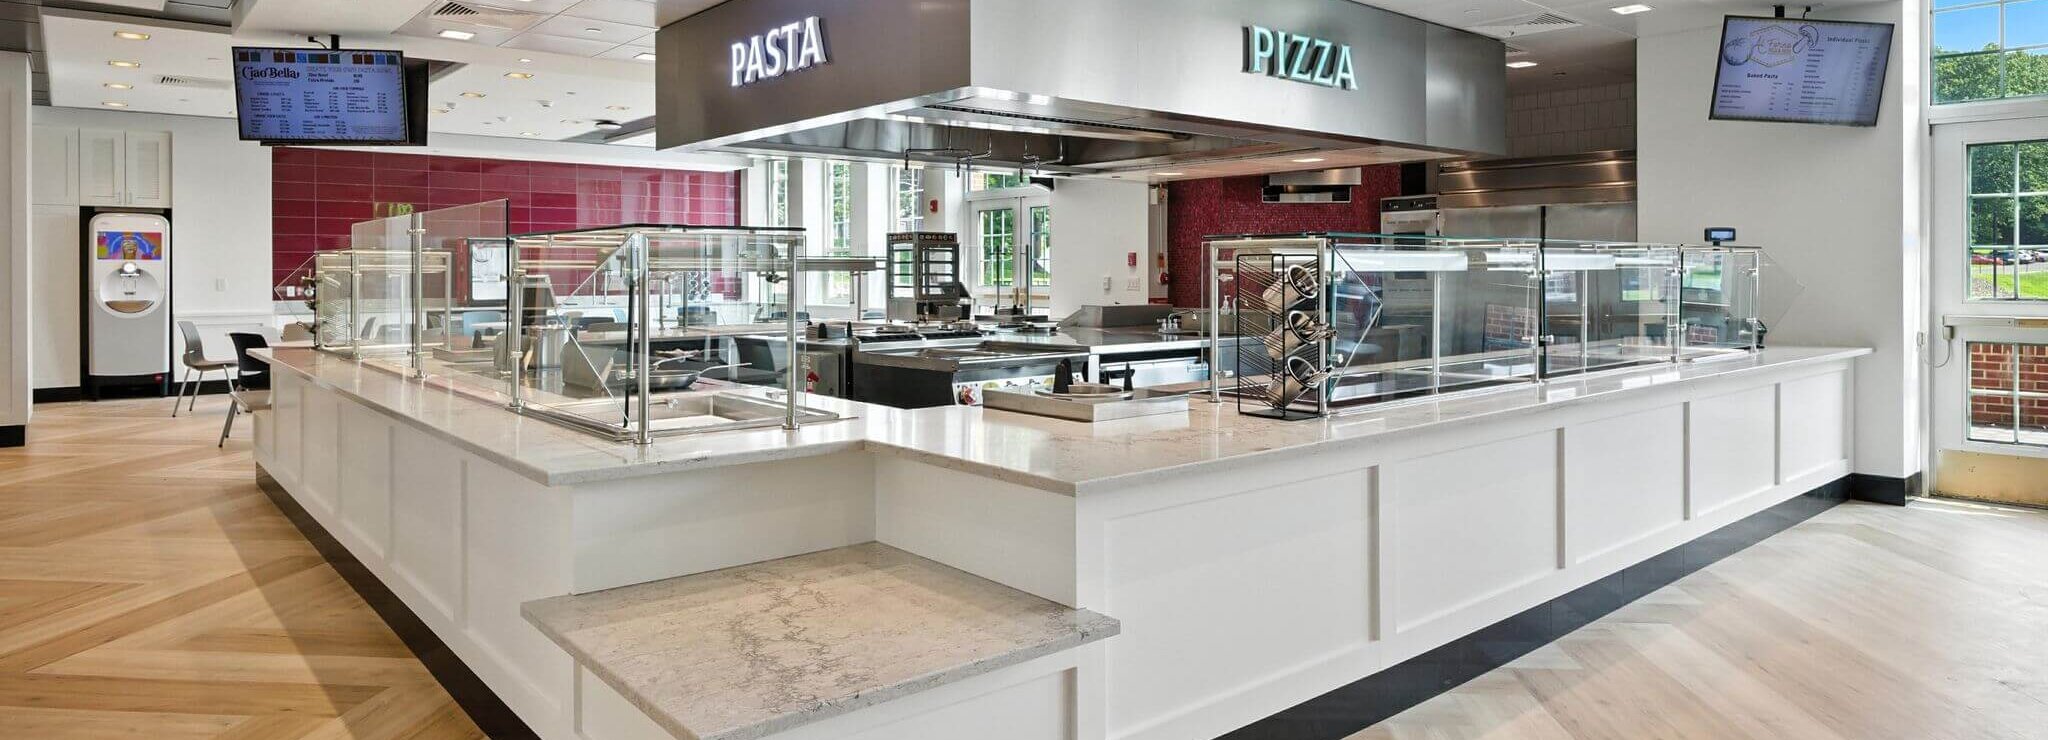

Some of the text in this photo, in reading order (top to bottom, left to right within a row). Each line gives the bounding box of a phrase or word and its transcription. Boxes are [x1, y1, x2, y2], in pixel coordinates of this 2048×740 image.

[242, 66, 300, 80] Ciao Bella
[730, 16, 827, 87] PASTA
[1253, 26, 1358, 90] PIZZA
